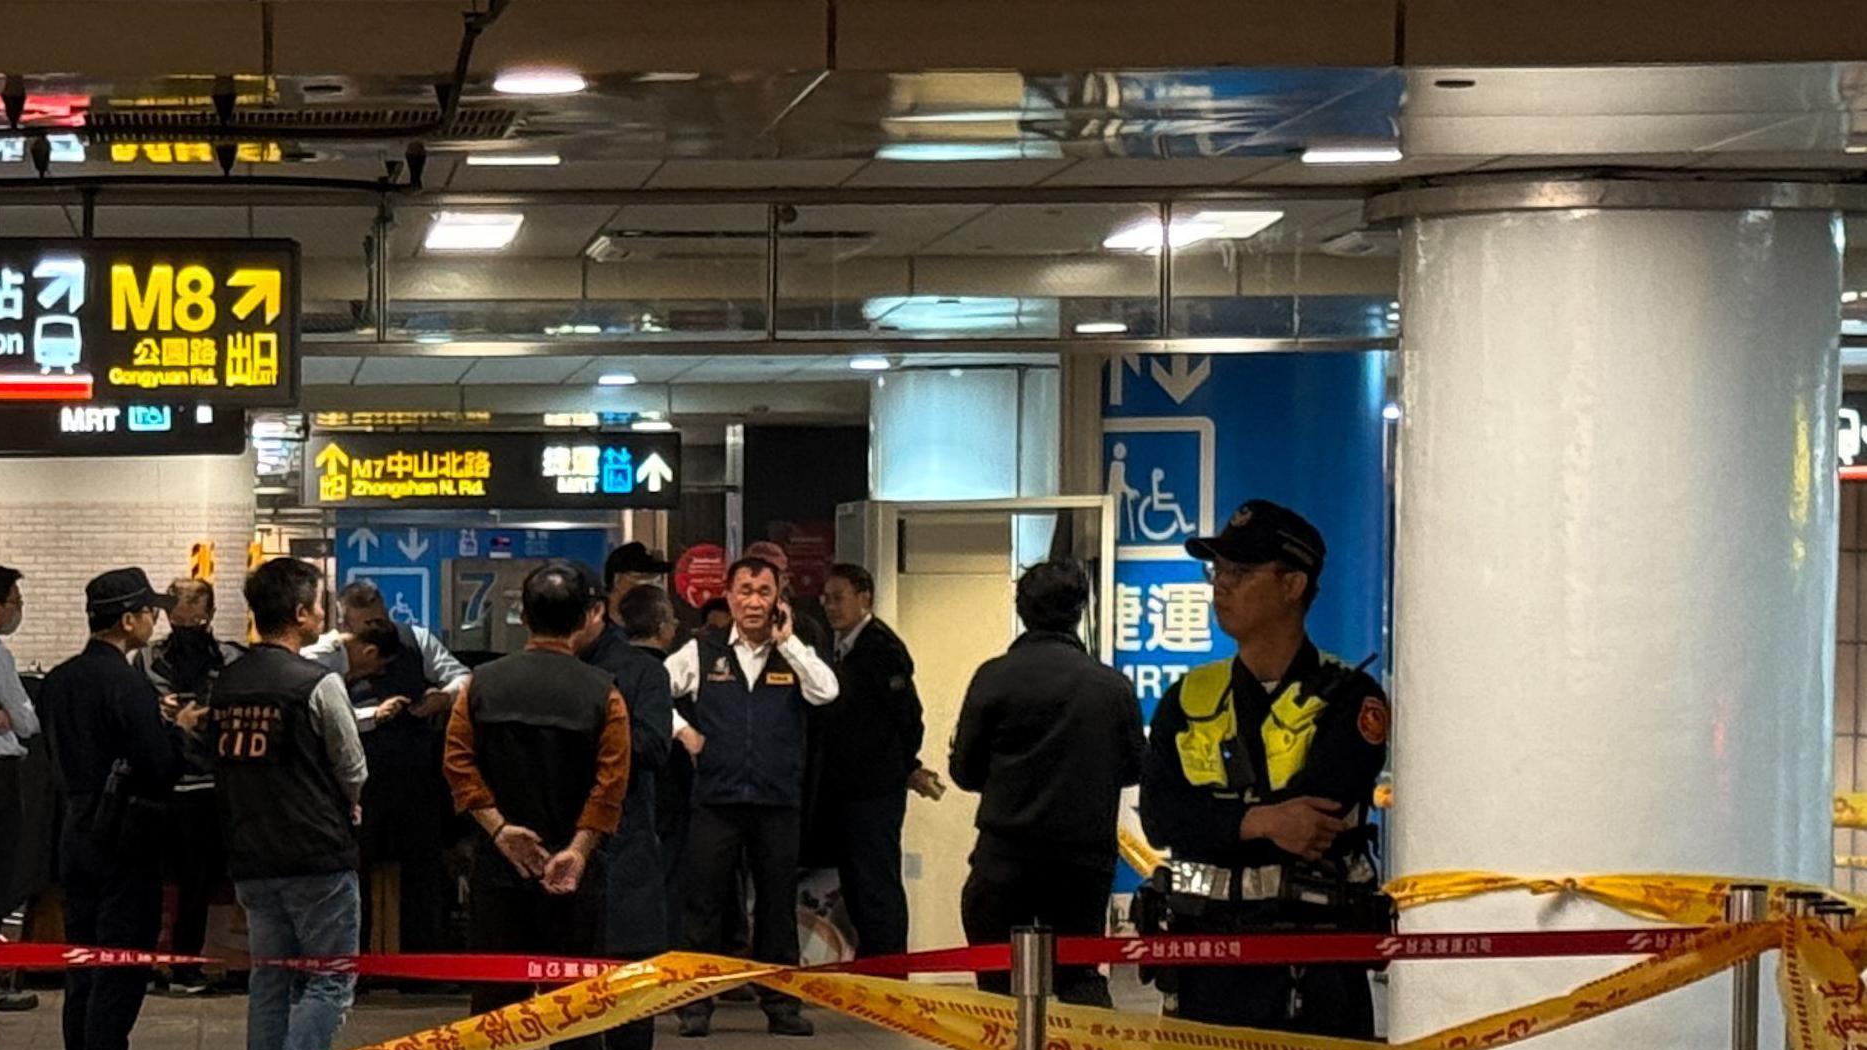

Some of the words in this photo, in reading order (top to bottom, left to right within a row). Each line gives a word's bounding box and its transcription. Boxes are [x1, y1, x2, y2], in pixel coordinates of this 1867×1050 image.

[110, 264, 216, 332] M8
[60, 406, 121, 432] MRT
[387, 450, 491, 479] 中山北路
[351, 479, 438, 499] Zhongshan
[439, 479, 457, 496] N.
[458, 479, 486, 496] Rd.
[217, 731, 267, 758] CID
